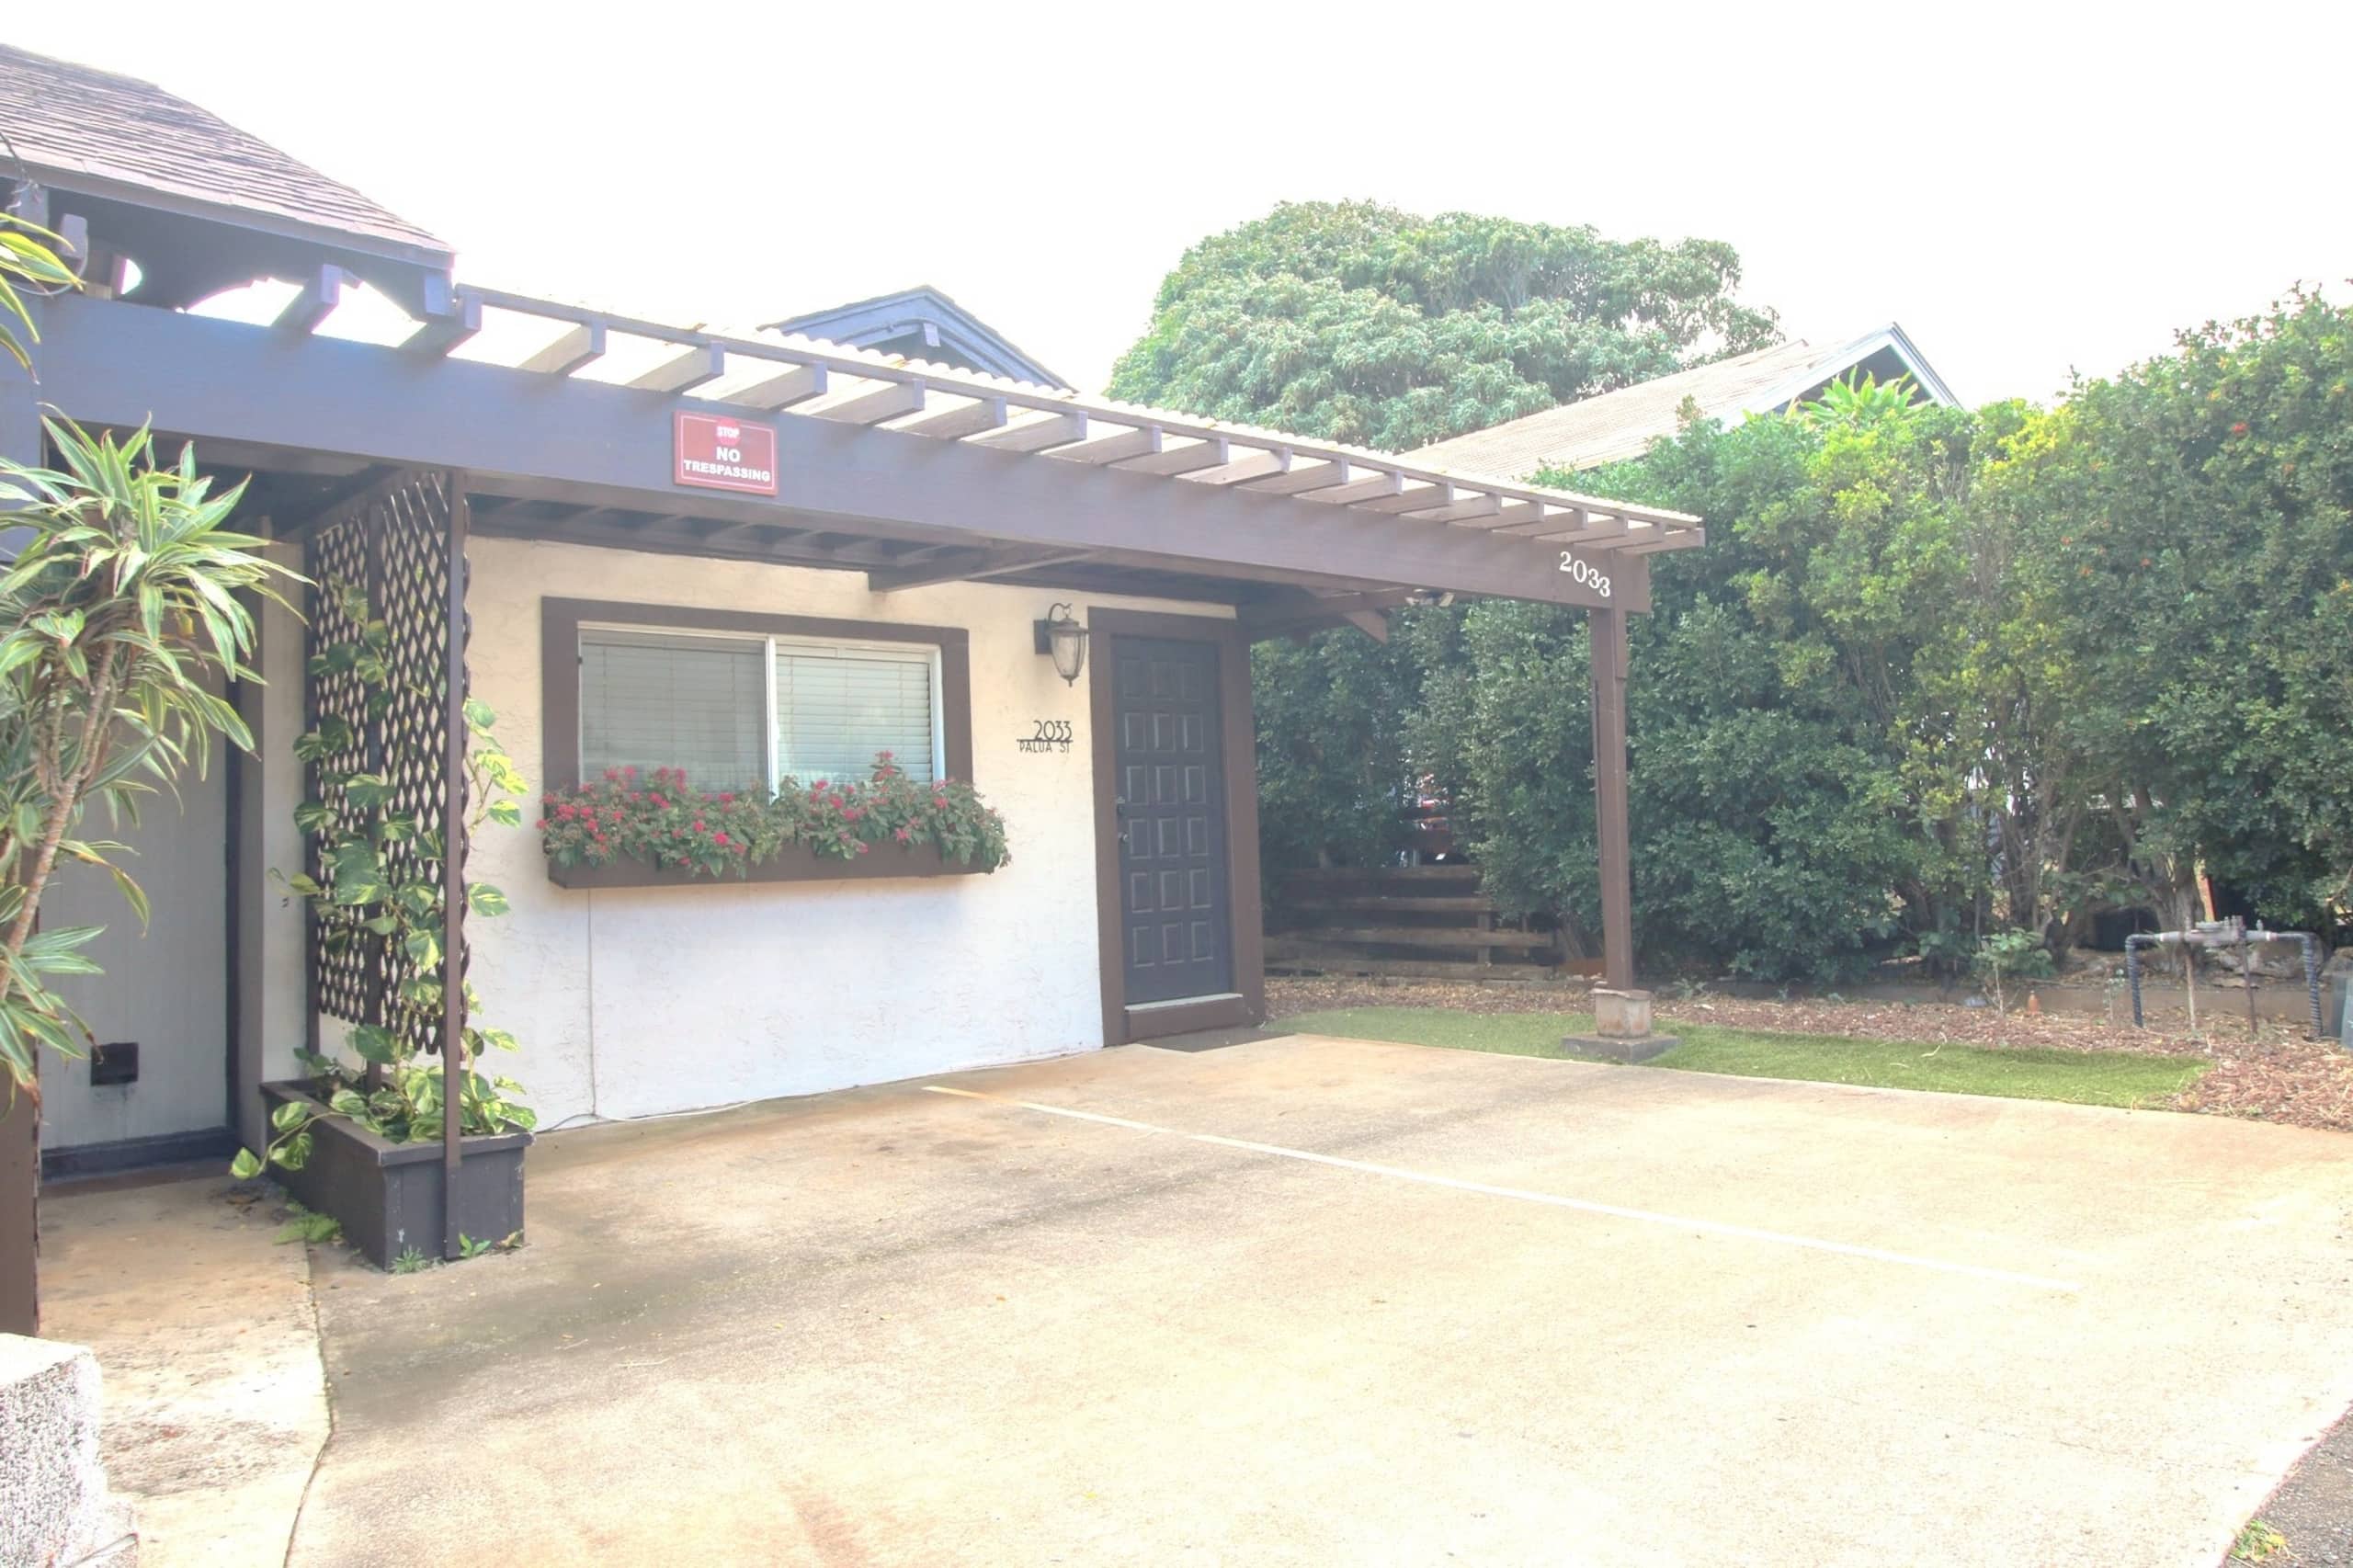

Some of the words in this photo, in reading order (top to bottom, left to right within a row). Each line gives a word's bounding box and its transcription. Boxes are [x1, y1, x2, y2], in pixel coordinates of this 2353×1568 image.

[717, 426, 740, 438] STOP
[716, 447, 741, 462] NO
[683, 460, 771, 482] TRESPASSING
[1559, 551, 1611, 597] 2033
[1033, 720, 1073, 742] 2033
[1019, 740, 1052, 753] PALUA
[1059, 741, 1070, 754] ST
